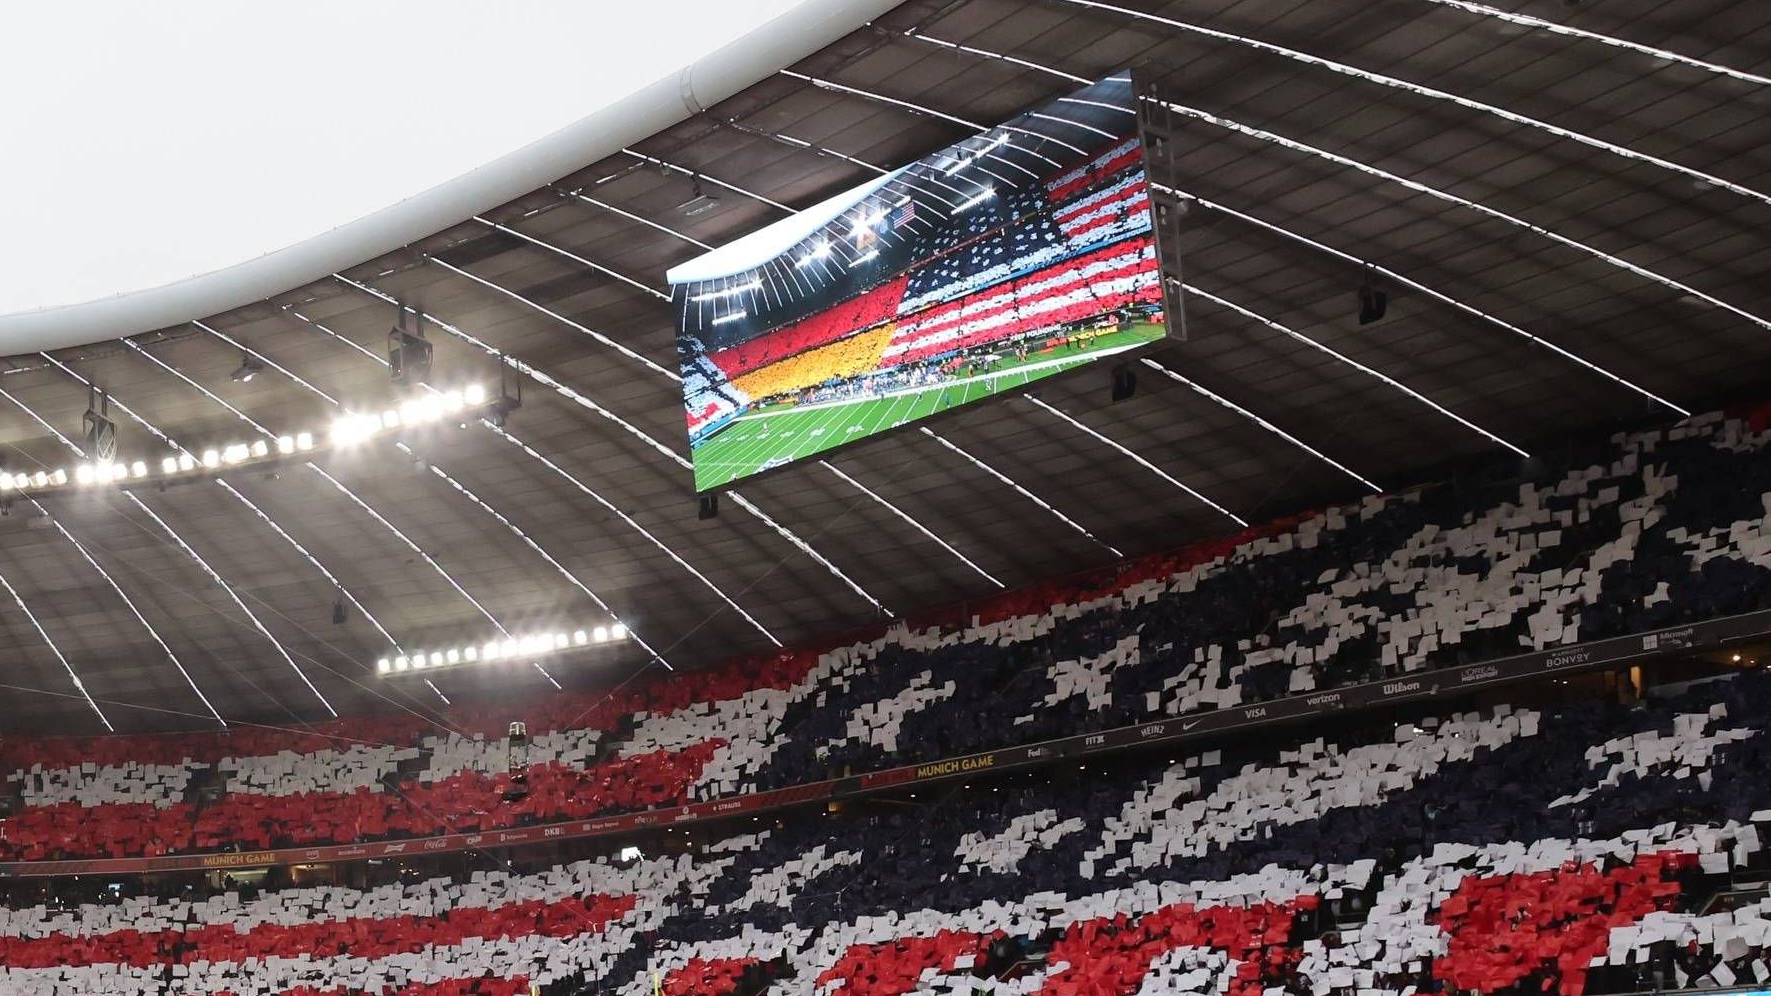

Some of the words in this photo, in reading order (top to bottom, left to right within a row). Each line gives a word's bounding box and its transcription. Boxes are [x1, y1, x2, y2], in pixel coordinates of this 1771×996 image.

[1546, 651, 1591, 668] BONVOY
[1383, 680, 1421, 696] Wilson
[1307, 692, 1341, 707] verizon
[1244, 707, 1267, 720] VISA
[1140, 724, 1165, 738] HEINZ
[917, 760, 960, 779] MUNICH
[961, 755, 994, 775] GAME
[204, 853, 246, 867] MUNICH
[246, 852, 276, 864] GAME
